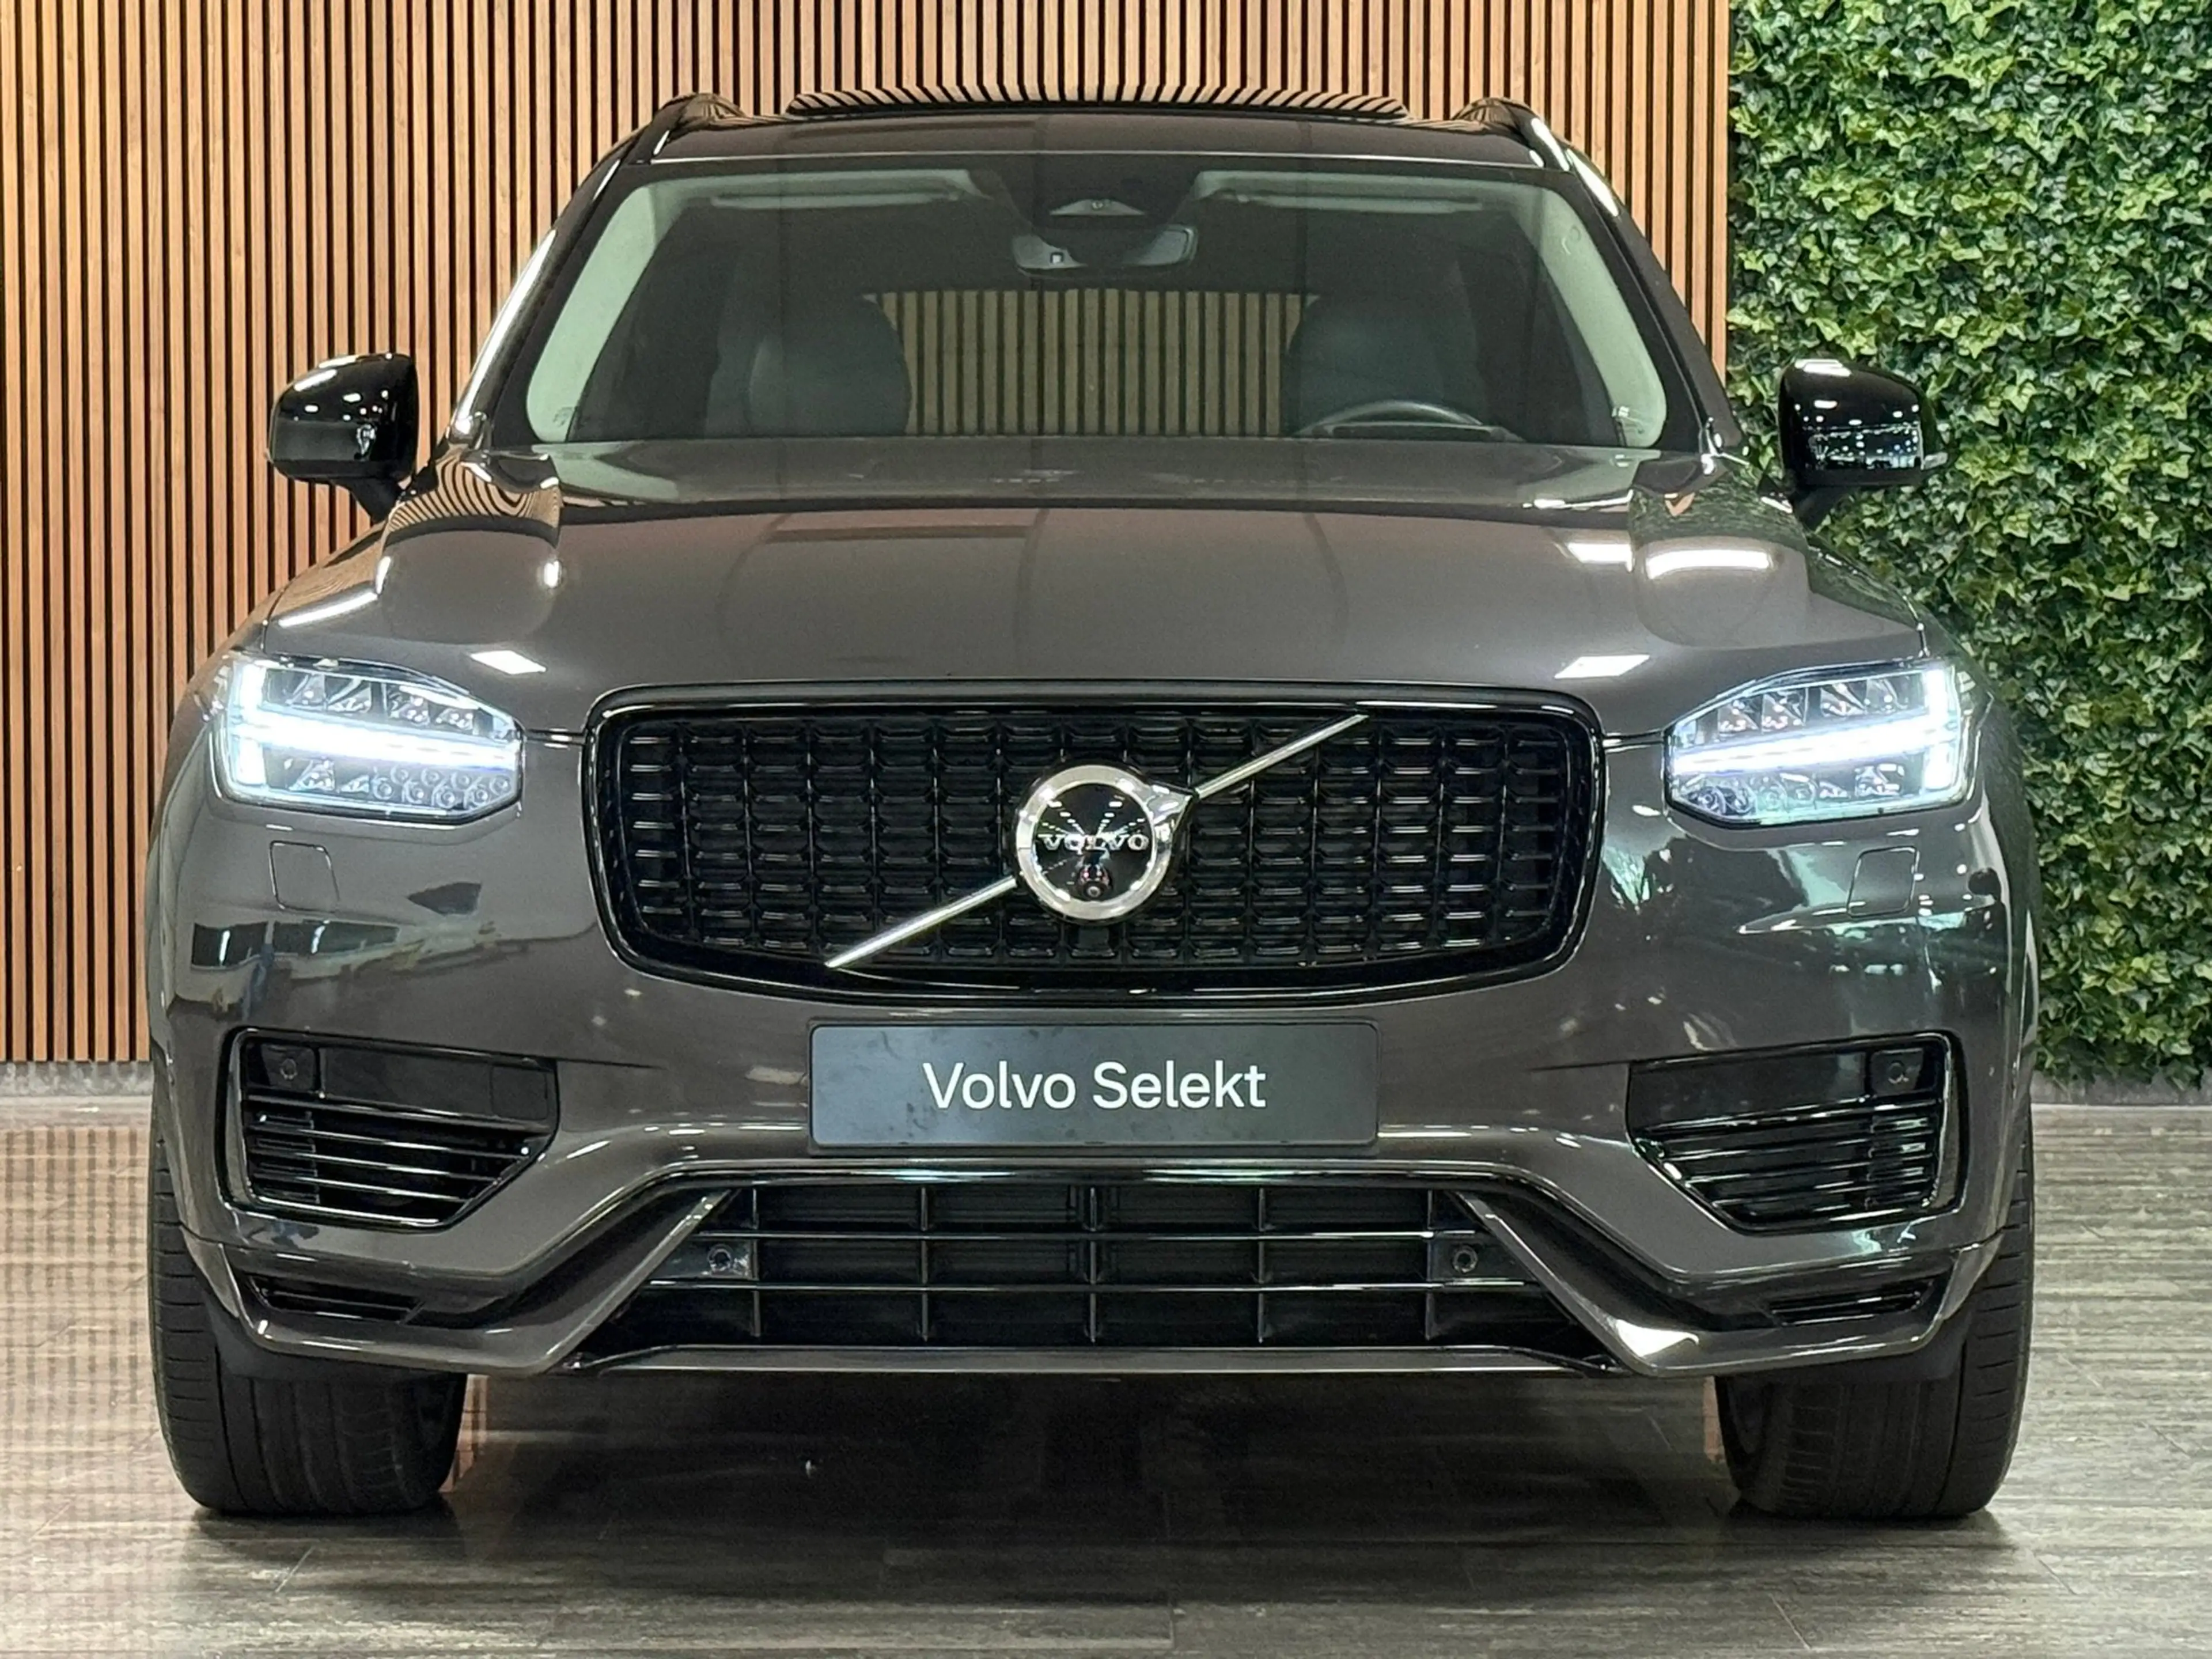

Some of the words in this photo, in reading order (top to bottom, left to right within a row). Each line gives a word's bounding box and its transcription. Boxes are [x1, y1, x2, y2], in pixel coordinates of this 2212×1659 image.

[1037, 833, 1150, 851] VOLVO
[923, 1060, 1076, 1109] Volvo
[1093, 1060, 1266, 1109] Selekt
